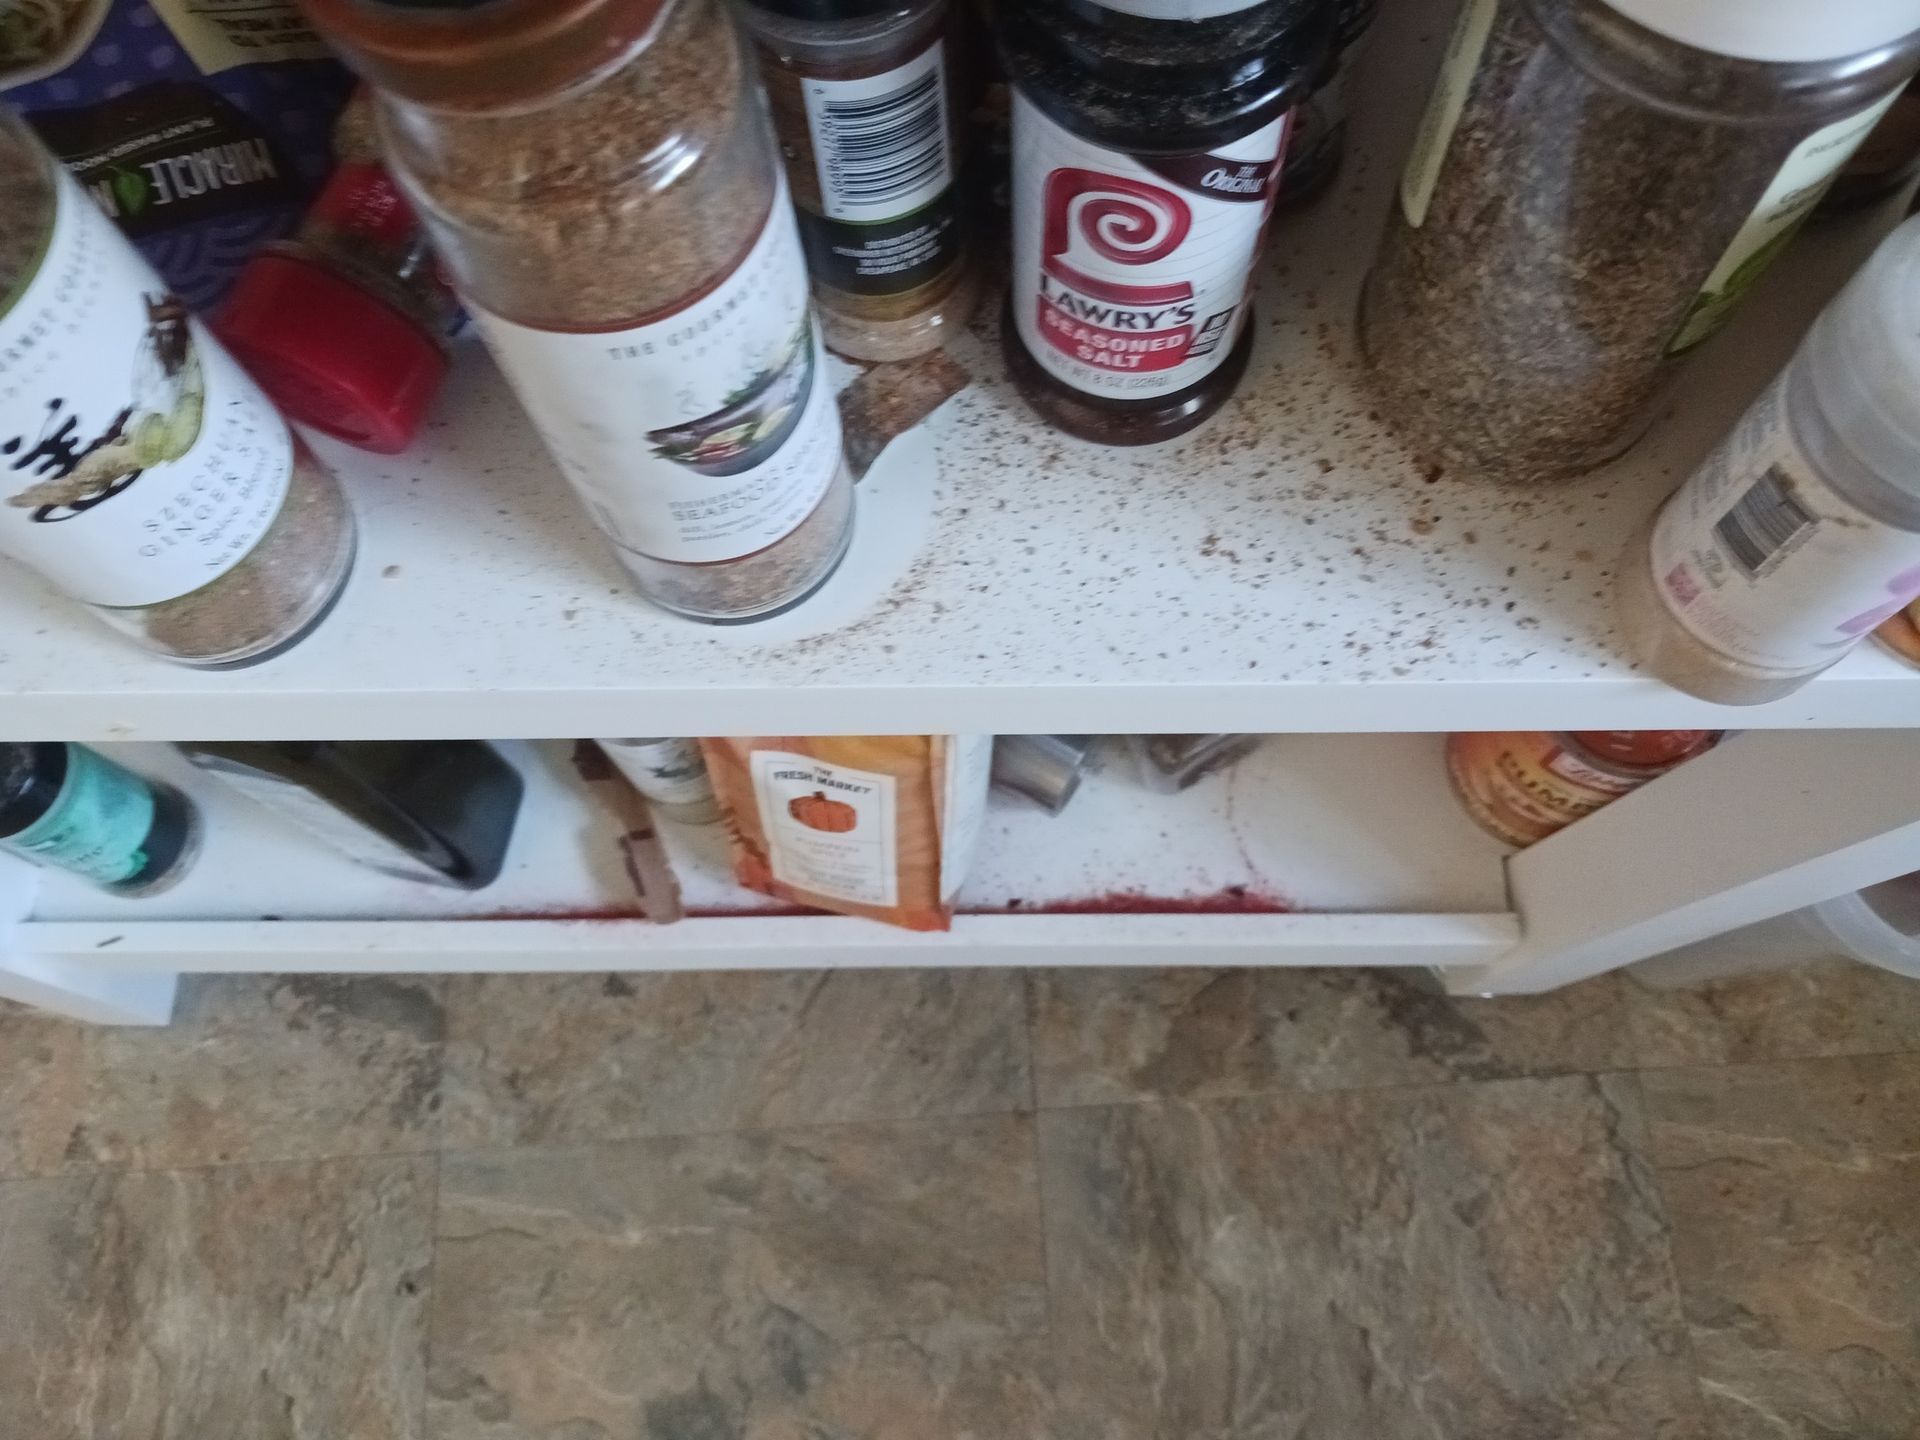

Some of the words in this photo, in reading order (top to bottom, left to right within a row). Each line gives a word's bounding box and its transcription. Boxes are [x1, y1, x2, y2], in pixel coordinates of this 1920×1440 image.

[140, 137, 279, 206] MIRACLE
[1038, 271, 1197, 331] LAWRY'S
[1043, 308, 1188, 353] SEASONED
[606, 341, 655, 361] THE
[1076, 345, 1145, 369] SALT
[773, 770, 813, 782] FRESH
[816, 776, 872, 795] MARKET
